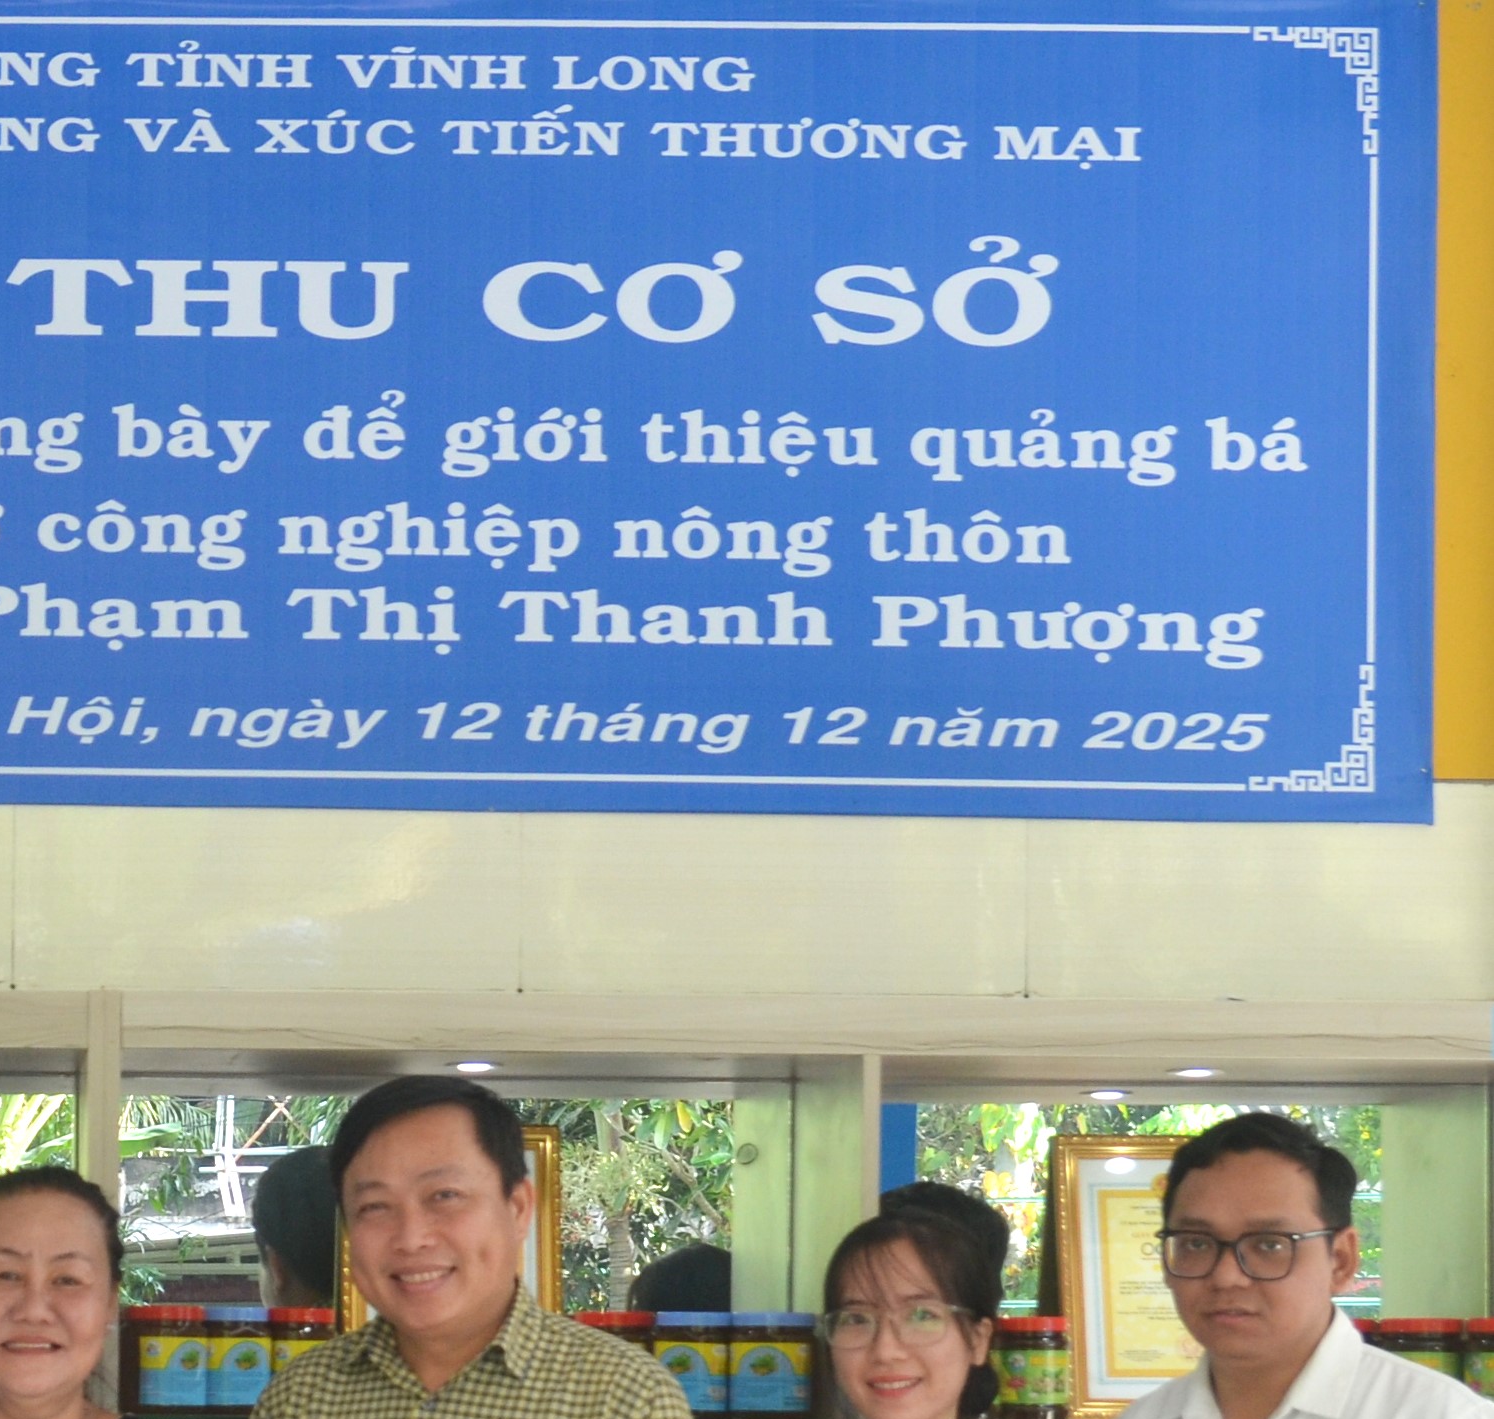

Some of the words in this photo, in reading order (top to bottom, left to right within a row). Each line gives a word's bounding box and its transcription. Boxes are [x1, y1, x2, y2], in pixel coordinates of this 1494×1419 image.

[126, 40, 312, 88] TỈNH
[336, 46, 526, 90] VĨNH
[553, 55, 755, 92] LONG
[124, 108, 231, 153] VÀ
[254, 109, 415, 155] XÚC
[441, 104, 625, 156] TIẾN
[650, 117, 968, 160] THƯƠNG
[993, 126, 1142, 170] MẠI
[6, 258, 409, 340] THU
[482, 250, 743, 343] CƠ
[812, 235, 1059, 347] SỞ
[112, 403, 271, 474] bày
[303, 389, 406, 460] để
[441, 406, 608, 478] giới
[640, 409, 878, 478] thiệu
[910, 408, 1178, 487] quảng
[1205, 416, 1309, 472] bá
[37, 499, 248, 571] công
[278, 501, 580, 573] nghiệp
[613, 505, 833, 578] nông
[864, 508, 1071, 564] thôn
[286, 586, 461, 655] Thị
[499, 588, 833, 646] Thanh
[872, 593, 1265, 670] Phượng
[7, 696, 158, 744] Hội,
[189, 699, 387, 749] ngày
[417, 702, 501, 740] 12
[525, 702, 750, 754] tháng
[783, 706, 867, 745] 12
[889, 707, 1059, 748] năm
[1082, 711, 1270, 752] 2025
